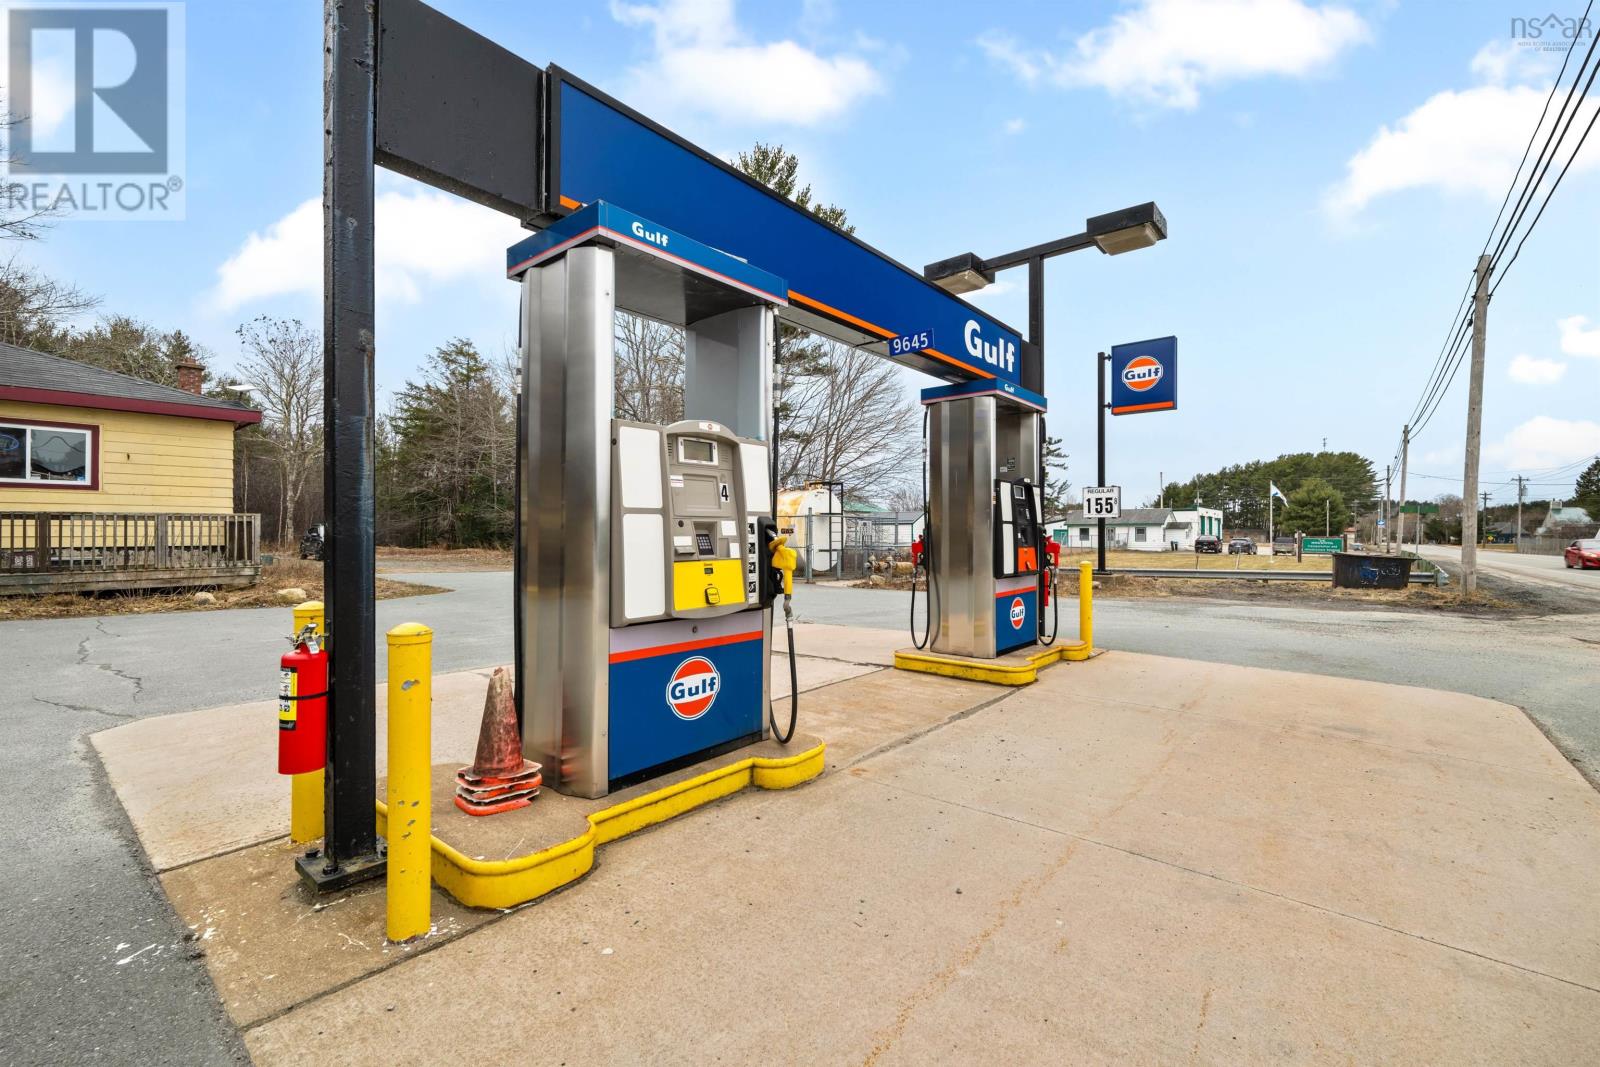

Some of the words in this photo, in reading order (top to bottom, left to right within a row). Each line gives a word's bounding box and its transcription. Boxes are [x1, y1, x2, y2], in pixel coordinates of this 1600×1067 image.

[632, 221, 668, 247] Gulf
[893, 332, 928, 353] 9645
[964, 320, 1015, 372] Gulf
[1124, 367, 1160, 380] Gulf
[721, 485, 729, 501] 4
[1011, 607, 1024, 618] Gulf
[670, 676, 716, 700] Gulf
